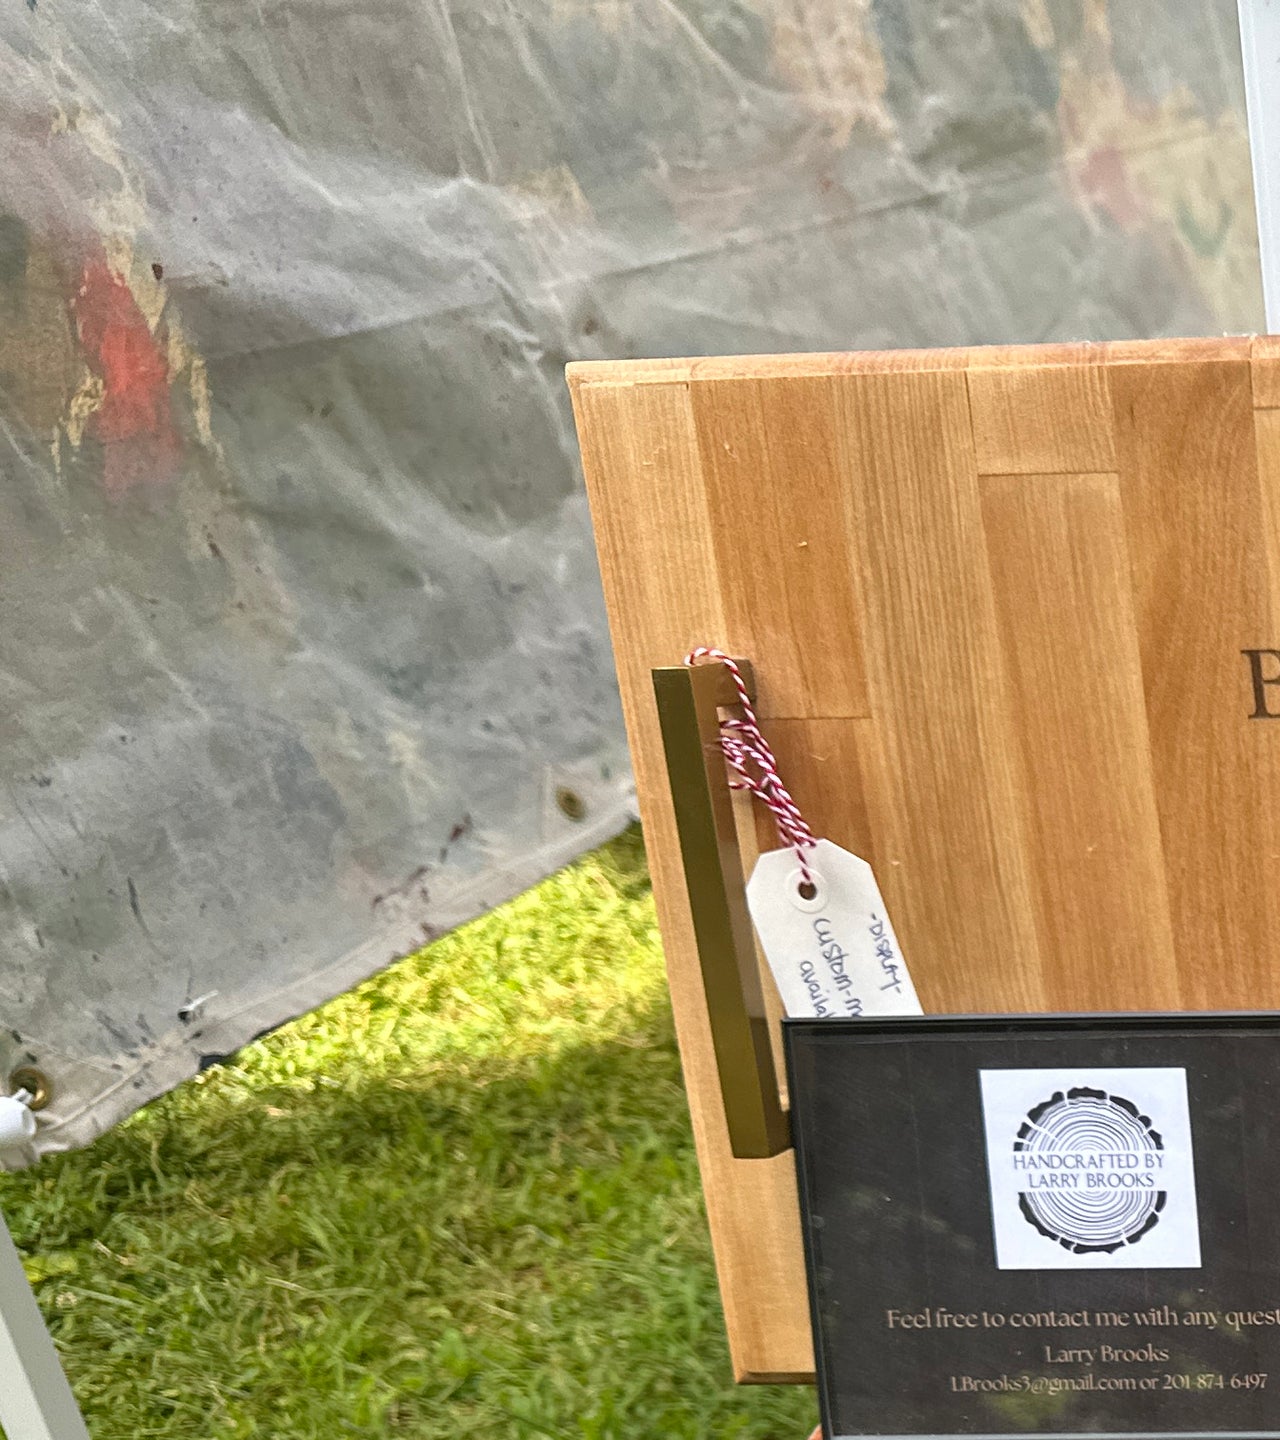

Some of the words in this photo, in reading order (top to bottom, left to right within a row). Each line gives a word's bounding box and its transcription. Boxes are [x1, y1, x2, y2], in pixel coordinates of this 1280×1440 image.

[1013, 1153, 1139, 1169] HANDCRAFTED
[1145, 1153, 1164, 1168] BY
[1029, 1172, 1079, 1188] LARRY
[1087, 1172, 1155, 1188] BROOKS
[887, 1307, 932, 1328] Feel
[936, 1307, 978, 1328] free
[982, 1310, 1005, 1327] to
[1010, 1309, 1090, 1327] contact
[1096, 1311, 1129, 1326] me
[1134, 1305, 1178, 1326] with
[1183, 1309, 1220, 1330] any
[1045, 1346, 1097, 1366] Larry
[1101, 1344, 1169, 1362] Brooks
[1139, 1376, 1159, 1390] or
